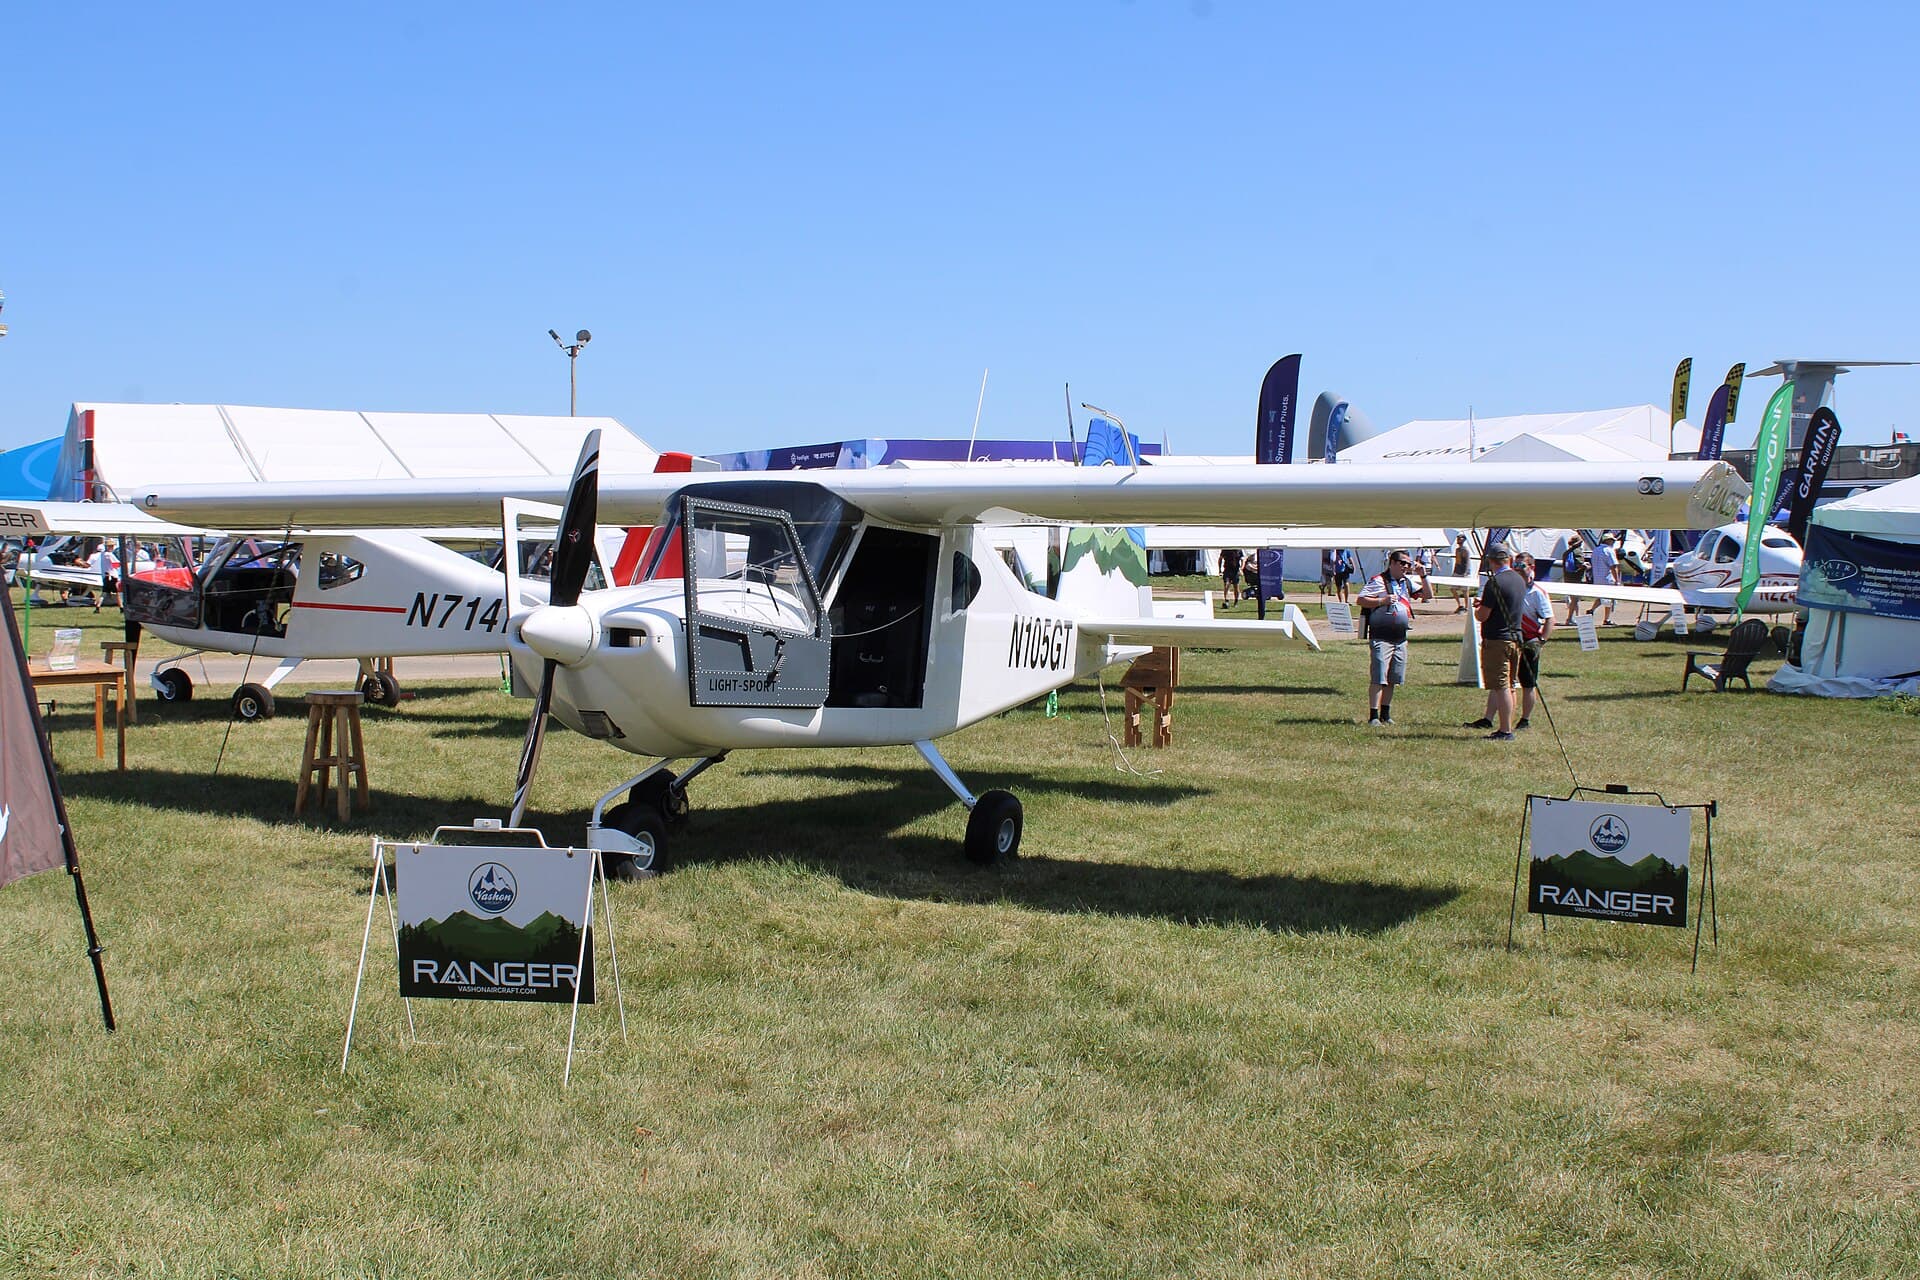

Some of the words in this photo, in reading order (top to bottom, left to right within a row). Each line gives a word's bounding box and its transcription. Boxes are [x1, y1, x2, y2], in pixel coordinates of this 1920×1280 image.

[1275, 422, 1287, 463] Smarter
[1800, 418, 1831, 498] GARMIN
[1821, 428, 1838, 467] EQUIPPED
[1771, 480, 1795, 513] GARMIN
[1008, 614, 1073, 671] N105GT
[709, 679, 777, 692] LIGHT-SPORT
[1594, 834, 1625, 845] Vashon
[474, 889, 512, 902] Vashon
[1539, 884, 1675, 915] RANGER
[413, 959, 578, 989] RANGER
[458, 985, 537, 995] VASHONAIRCRAFT.COM
